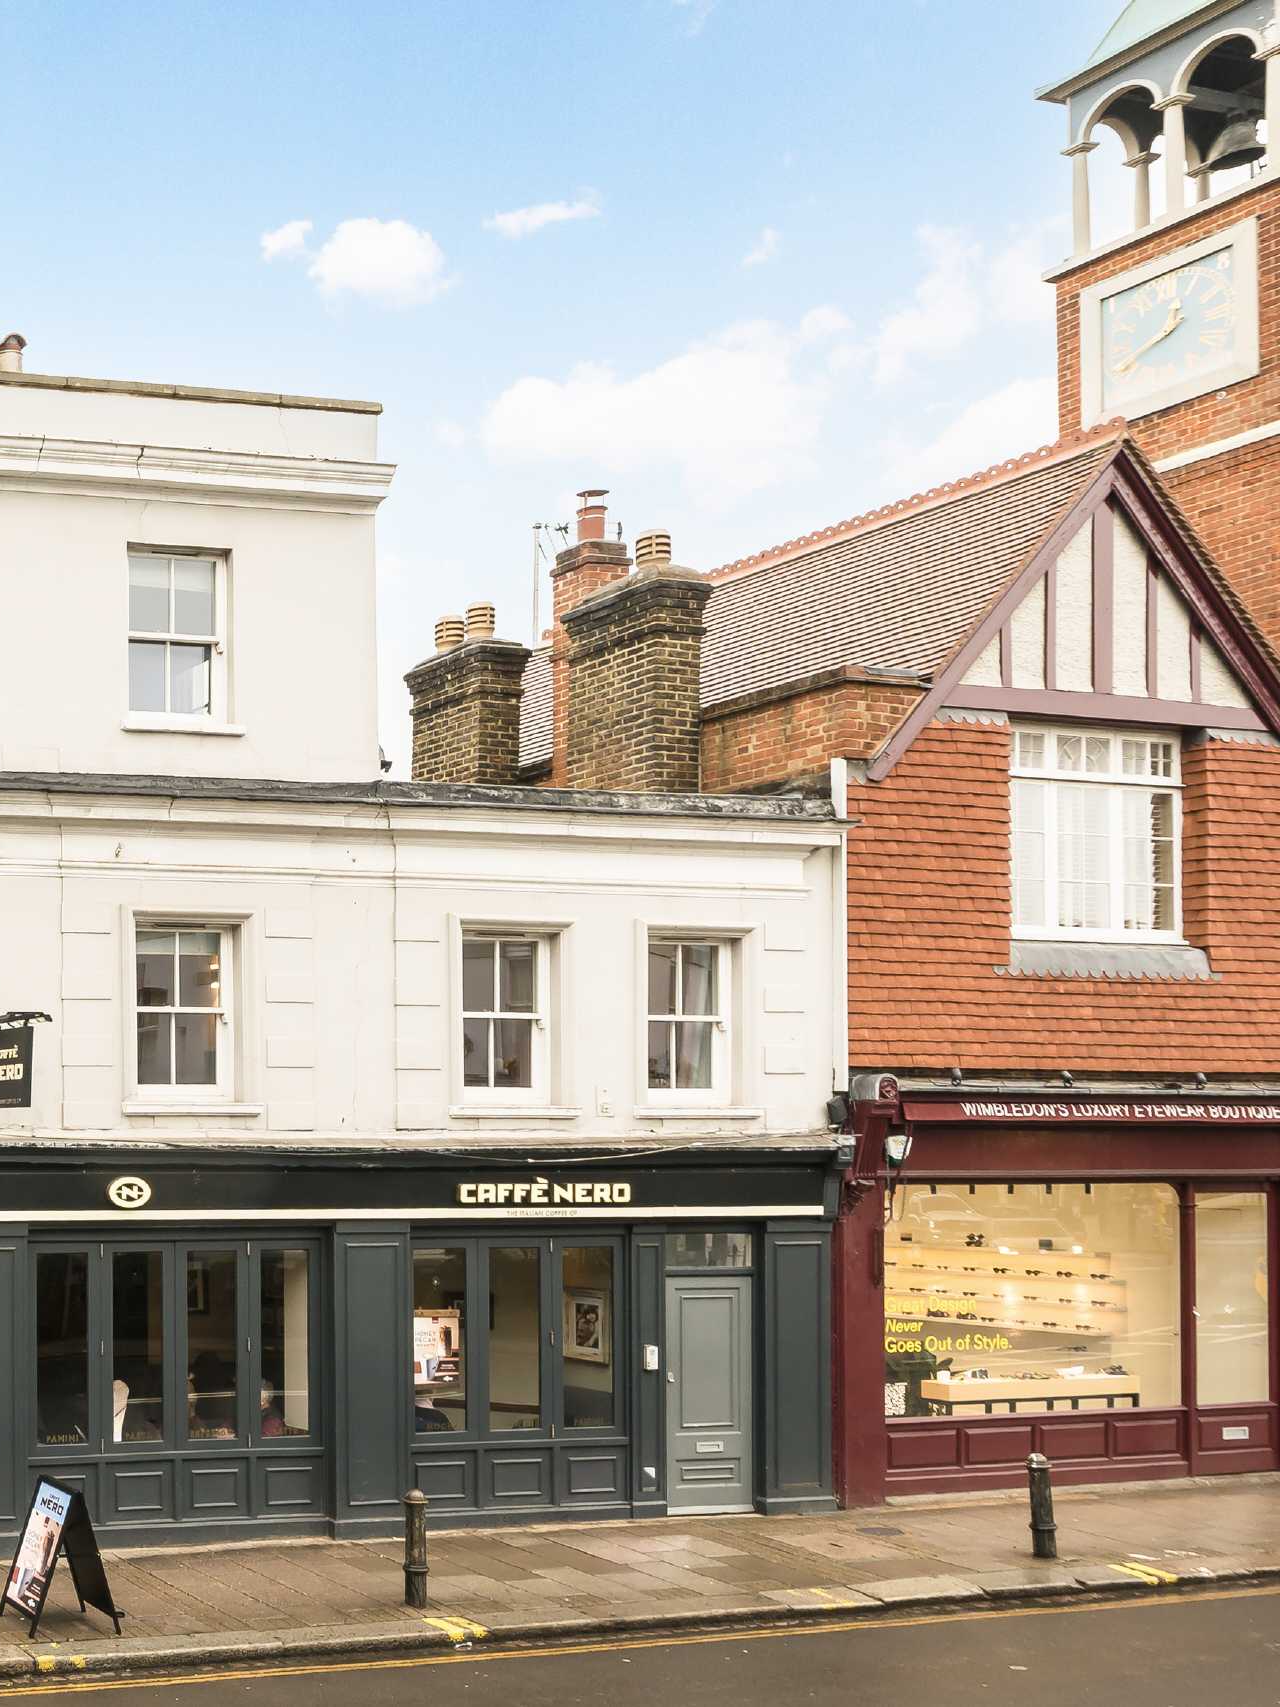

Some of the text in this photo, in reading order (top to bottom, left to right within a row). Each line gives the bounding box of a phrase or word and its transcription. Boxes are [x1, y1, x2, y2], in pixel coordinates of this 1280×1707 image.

[960, 1102, 1070, 1118] WIMBLEDON'S
[1070, 1103, 1130, 1118] LUXURY
[1133, 1104, 1207, 1118] EYEWEAR
[459, 1176, 631, 1204] CAFFÈ NERO
[885, 1296, 977, 1314] Great Design
[885, 1319, 924, 1333] Never
[884, 1333, 1013, 1353] Goes Out of Style.
[39, 1496, 64, 1516] NERO
